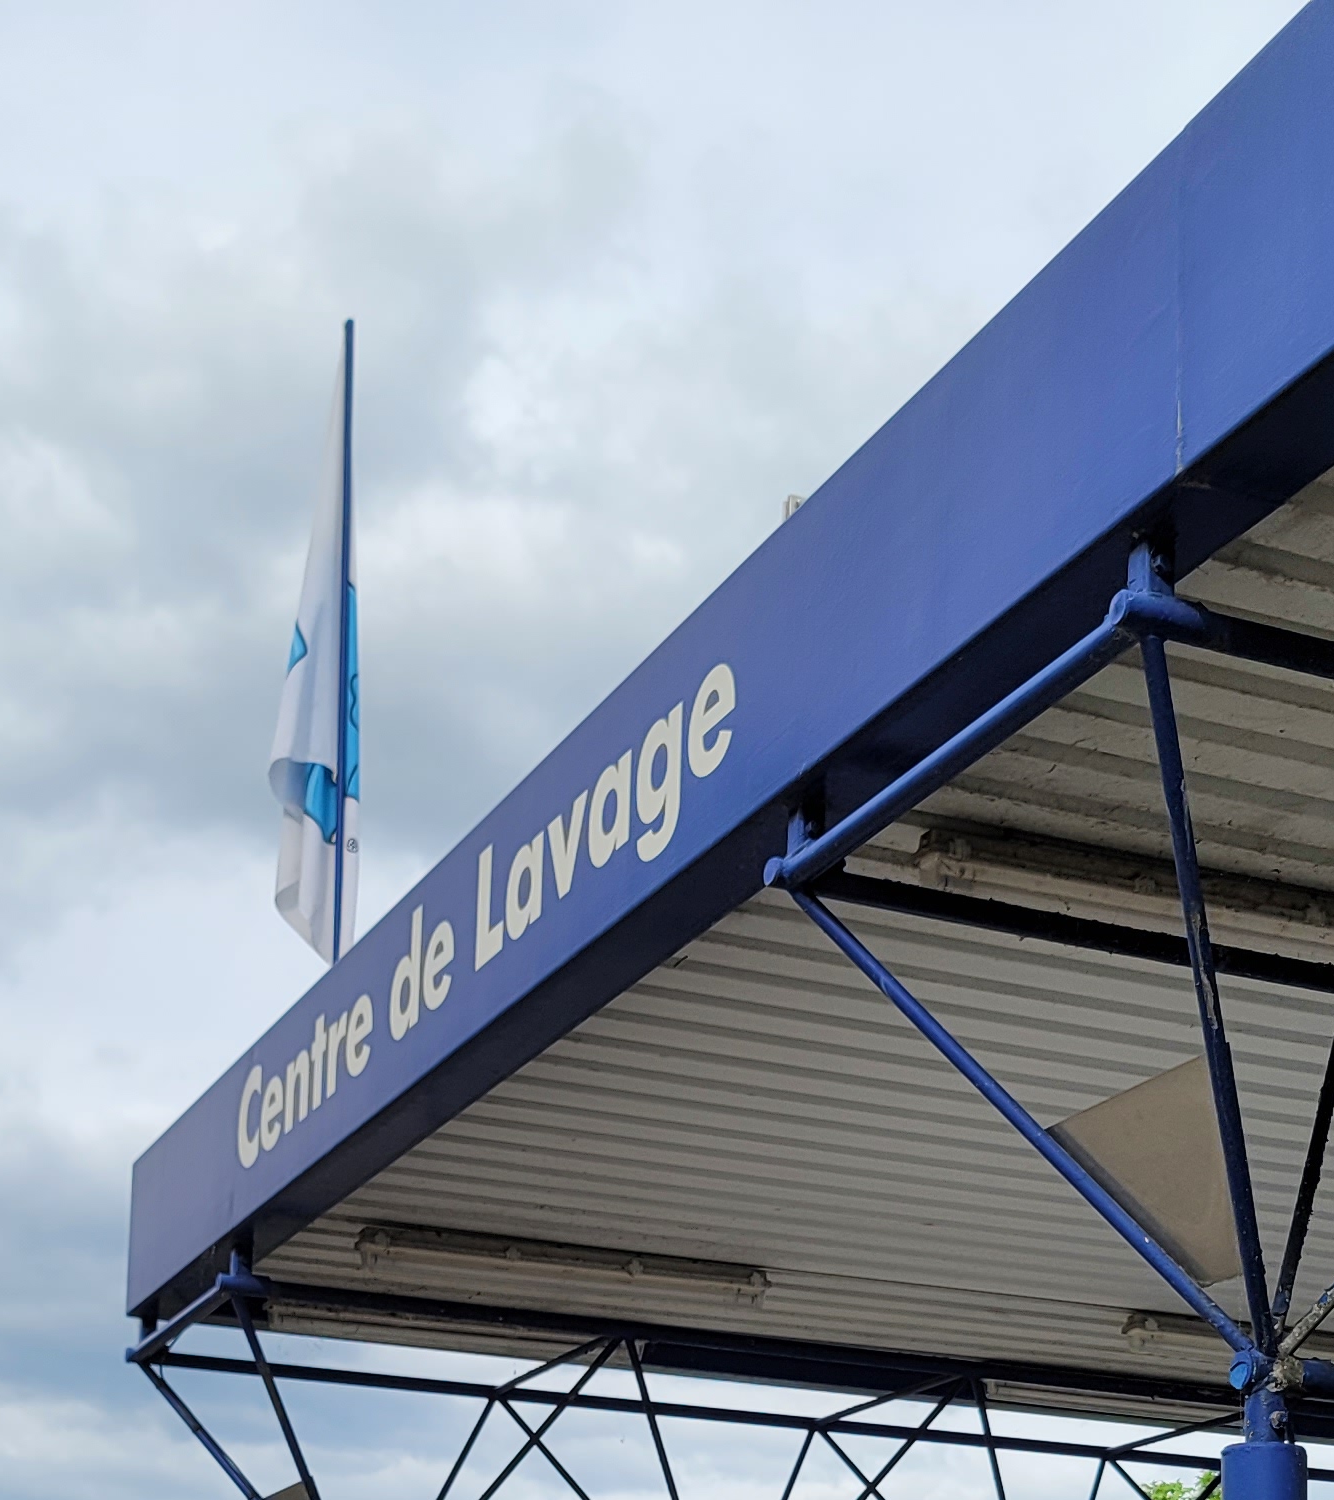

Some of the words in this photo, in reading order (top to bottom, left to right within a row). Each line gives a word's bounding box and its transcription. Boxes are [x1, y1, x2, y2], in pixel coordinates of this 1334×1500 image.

[237, 993, 374, 1169] Centre
[389, 904, 455, 1041] de
[474, 662, 737, 972] Lavage
